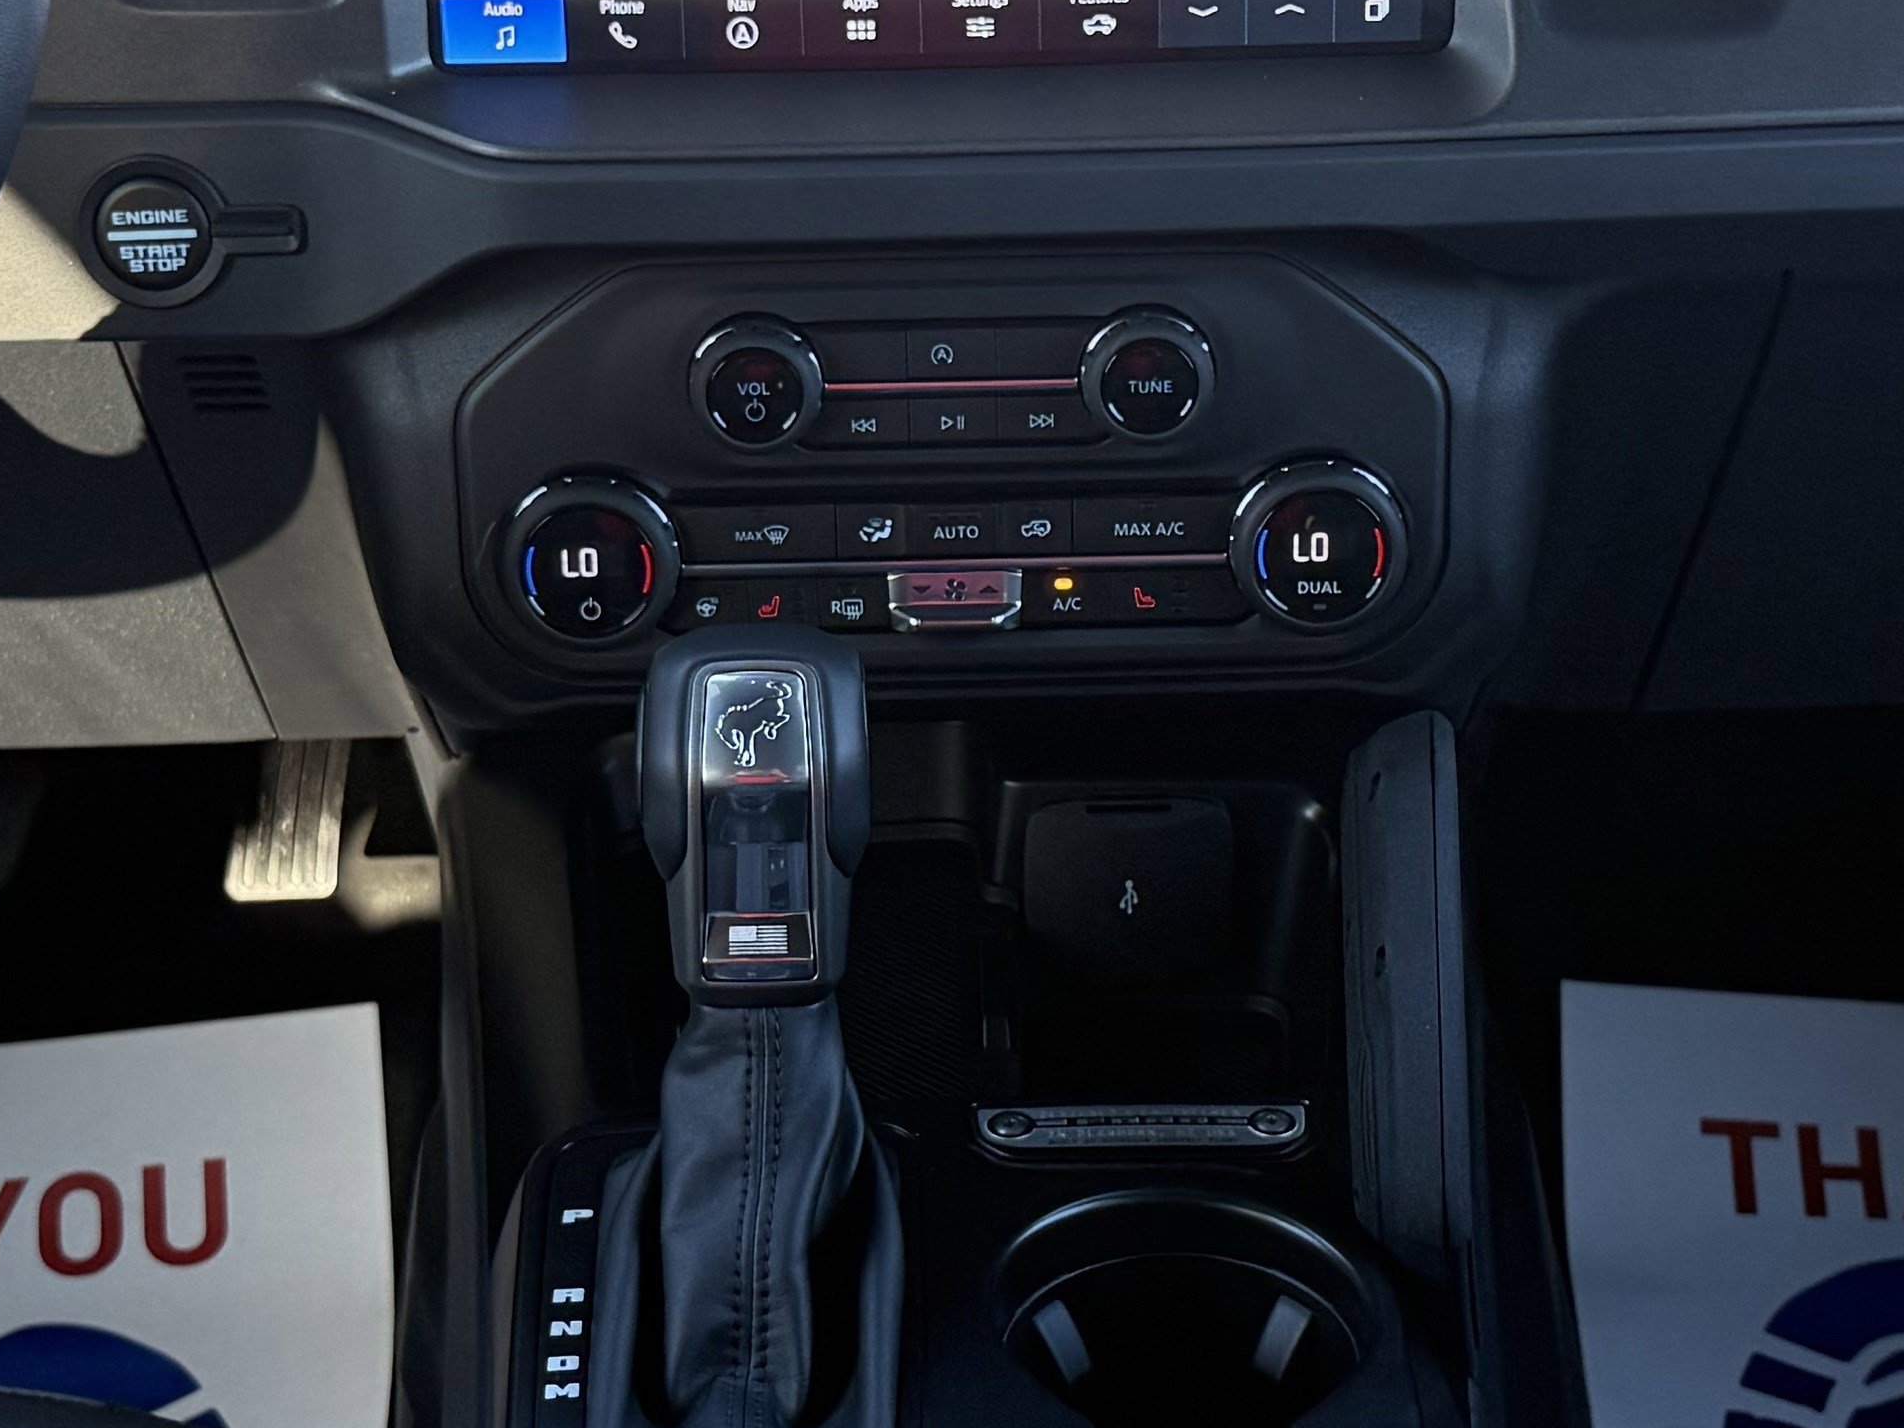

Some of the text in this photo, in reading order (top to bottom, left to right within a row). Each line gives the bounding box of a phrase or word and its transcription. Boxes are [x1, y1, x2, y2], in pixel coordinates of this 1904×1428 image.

[484, 2, 522, 16] Audio
[600, 0, 644, 14] Phone
[111, 208, 189, 225] ENGINE
[119, 243, 190, 259] START
[130, 258, 186, 273] STOP
[737, 382, 770, 396] VOL
[1129, 380, 1172, 393] TUNE
[736, 528, 763, 544] MAX
[934, 526, 978, 539] AUTO
[1115, 522, 1183, 536] MAX A/C
[1293, 532, 1328, 562] LO
[561, 548, 598, 577] LO
[1298, 581, 1341, 594] DUAL
[1053, 598, 1081, 611] A/C
